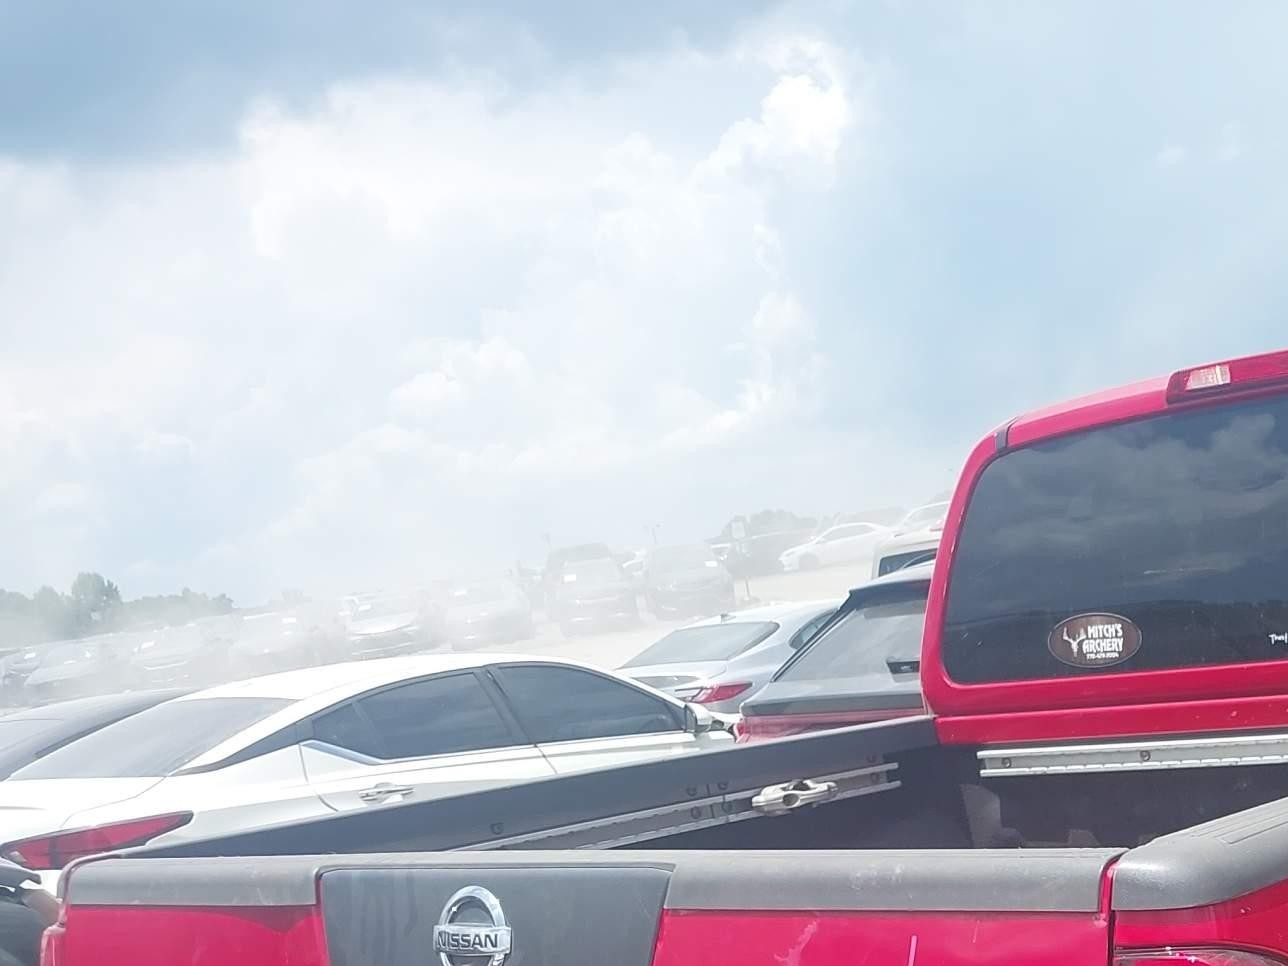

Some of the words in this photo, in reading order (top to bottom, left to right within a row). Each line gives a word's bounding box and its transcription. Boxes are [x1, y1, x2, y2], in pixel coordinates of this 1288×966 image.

[1087, 623, 1123, 639] MITCH'S
[1082, 637, 1124, 654] ARCHERY
[437, 933, 498, 949] NISSAN
